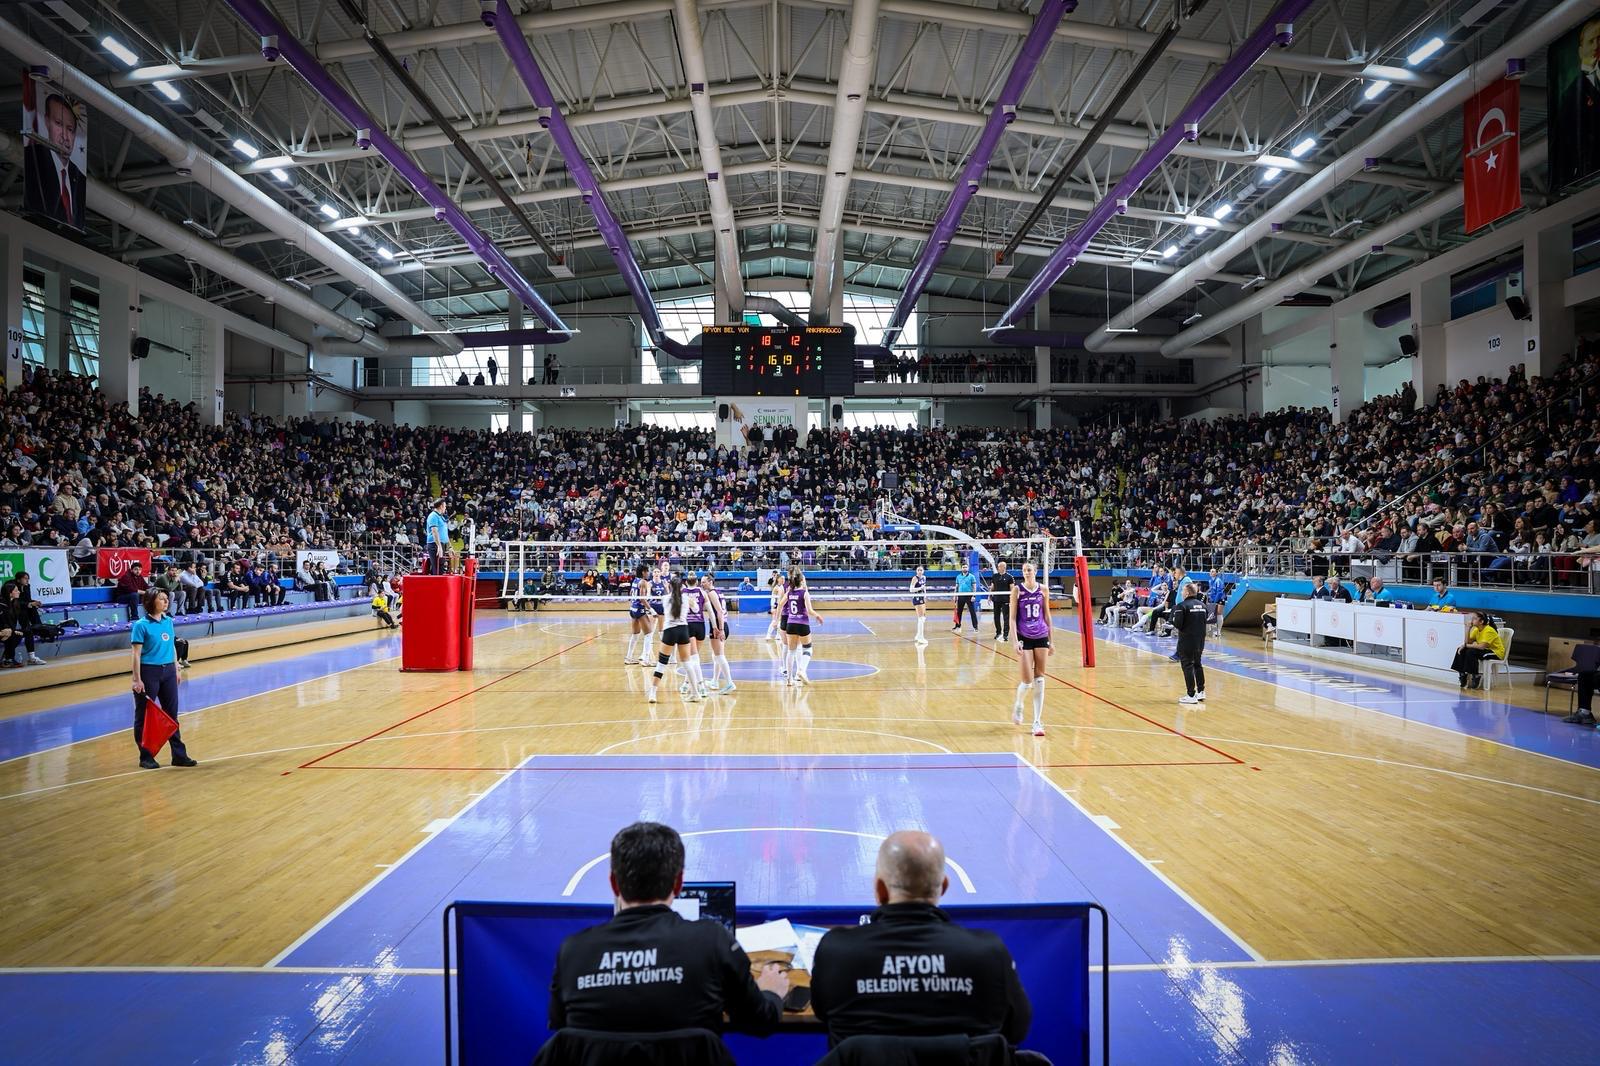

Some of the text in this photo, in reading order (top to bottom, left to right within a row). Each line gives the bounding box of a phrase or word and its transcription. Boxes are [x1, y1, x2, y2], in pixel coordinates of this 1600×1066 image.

[8, 330, 23, 342] 109
[761, 335, 771, 346] 18
[791, 335, 801, 346] 12
[1488, 337, 1501, 349] 103
[1527, 339, 1536, 352] D
[12, 347, 19, 359] J
[768, 354, 793, 366] 16 19
[775, 365, 782, 374] 3
[1333, 398, 1339, 408] E
[790, 600, 799, 615] 6
[1024, 603, 1041, 618] 18
[599, 948, 658, 970] AFYON
[882, 954, 946, 975] AFYON
[577, 966, 684, 990] BELEDİYE YÜNTAŞ
[856, 974, 974, 995] BELEDİYE YÜNTAŞ
